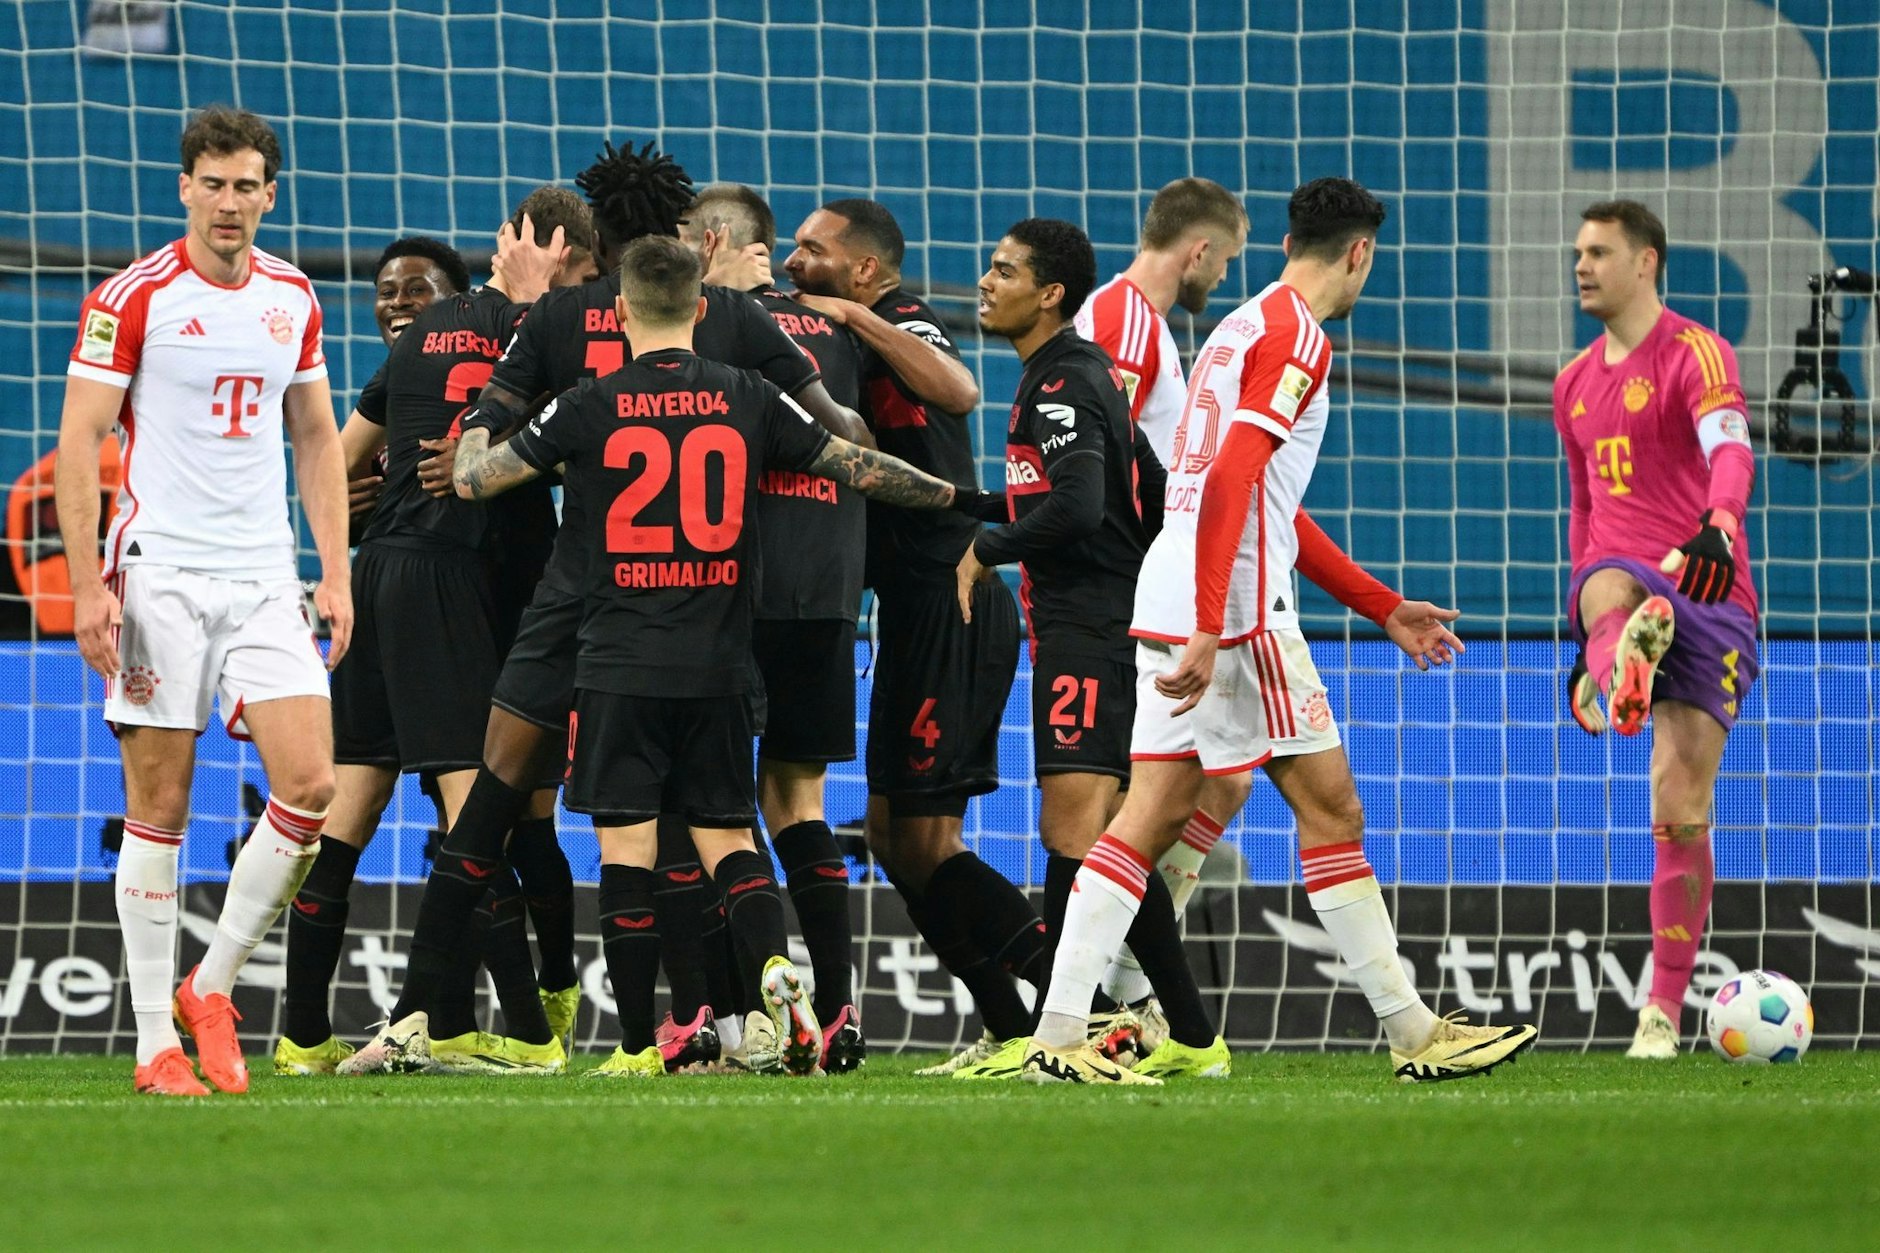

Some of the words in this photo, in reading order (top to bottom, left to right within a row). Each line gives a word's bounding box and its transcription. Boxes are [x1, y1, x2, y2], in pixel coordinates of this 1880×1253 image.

[770, 312, 833, 337] ER04
[1041, 431, 1078, 455] trive
[603, 424, 748, 554] 20
[614, 559, 739, 588] GRIMALDO
[1048, 674, 1099, 729] 21
[910, 697, 942, 749] 4
